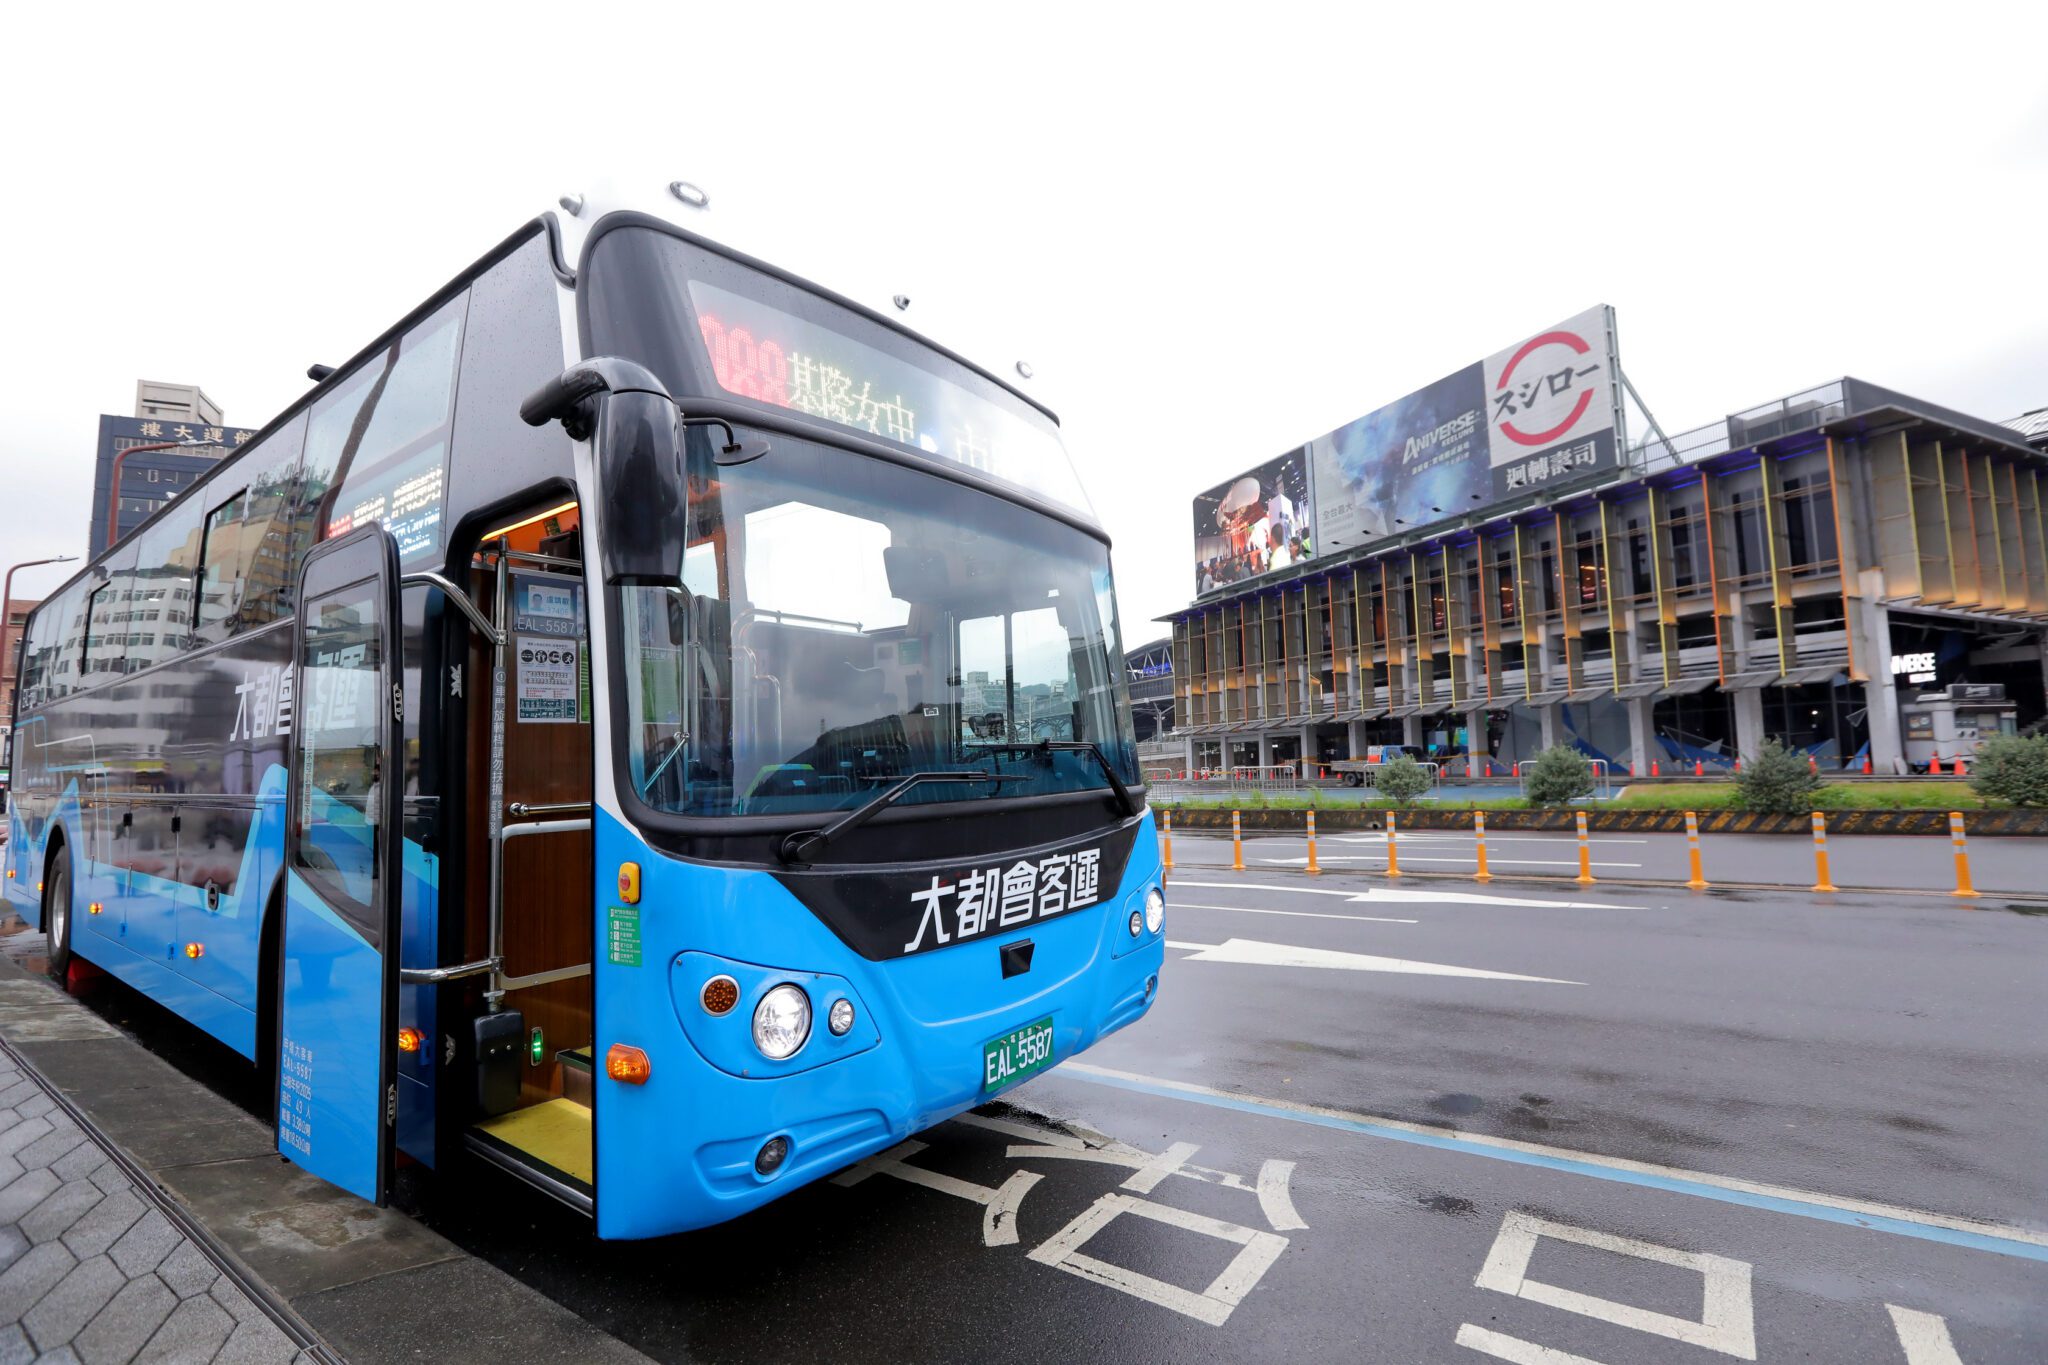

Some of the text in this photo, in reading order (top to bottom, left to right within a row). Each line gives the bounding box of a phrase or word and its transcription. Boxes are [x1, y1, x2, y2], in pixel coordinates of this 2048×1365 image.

[787, 352, 916, 443] 基隆女中
[1492, 363, 1601, 424] スシロー
[1402, 409, 1475, 465] ANIVERSE
[1441, 425, 1475, 448] KEELUNG
[517, 617, 575, 634] EAL-5587
[904, 848, 1101, 953] 大都會客運
[283, 1054, 312, 1082] EAL-5587
